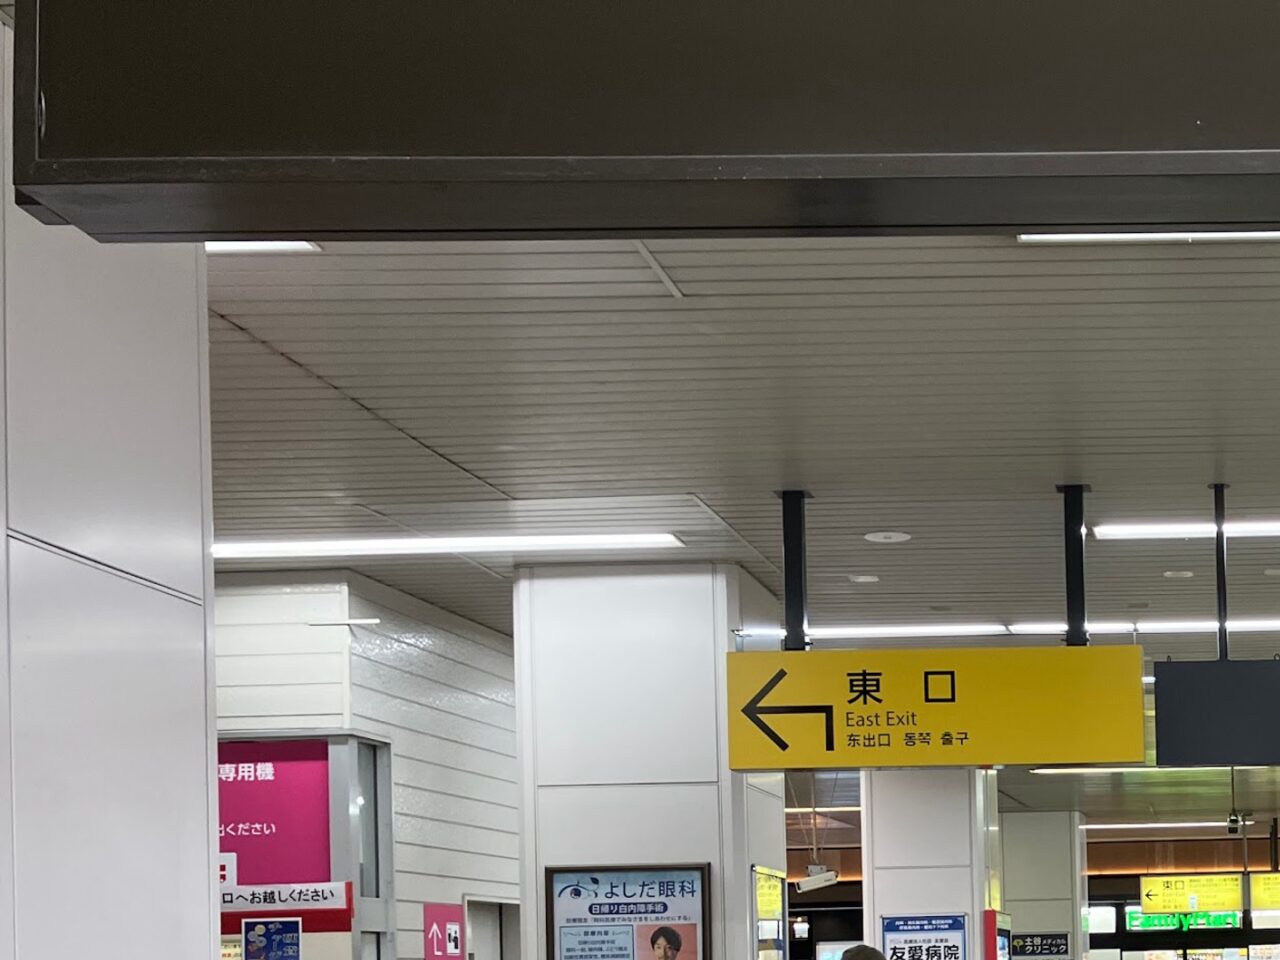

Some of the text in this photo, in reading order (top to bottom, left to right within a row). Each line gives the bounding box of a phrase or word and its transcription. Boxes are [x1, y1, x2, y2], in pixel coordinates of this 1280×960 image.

[846, 670, 956, 705] 東口
[846, 711, 917, 727] East Exit
[847, 731, 969, 748] 东出口 동쪽 출구
[222, 888, 334, 904] 口へお越しください
[604, 880, 697, 899] よしだ眼科
